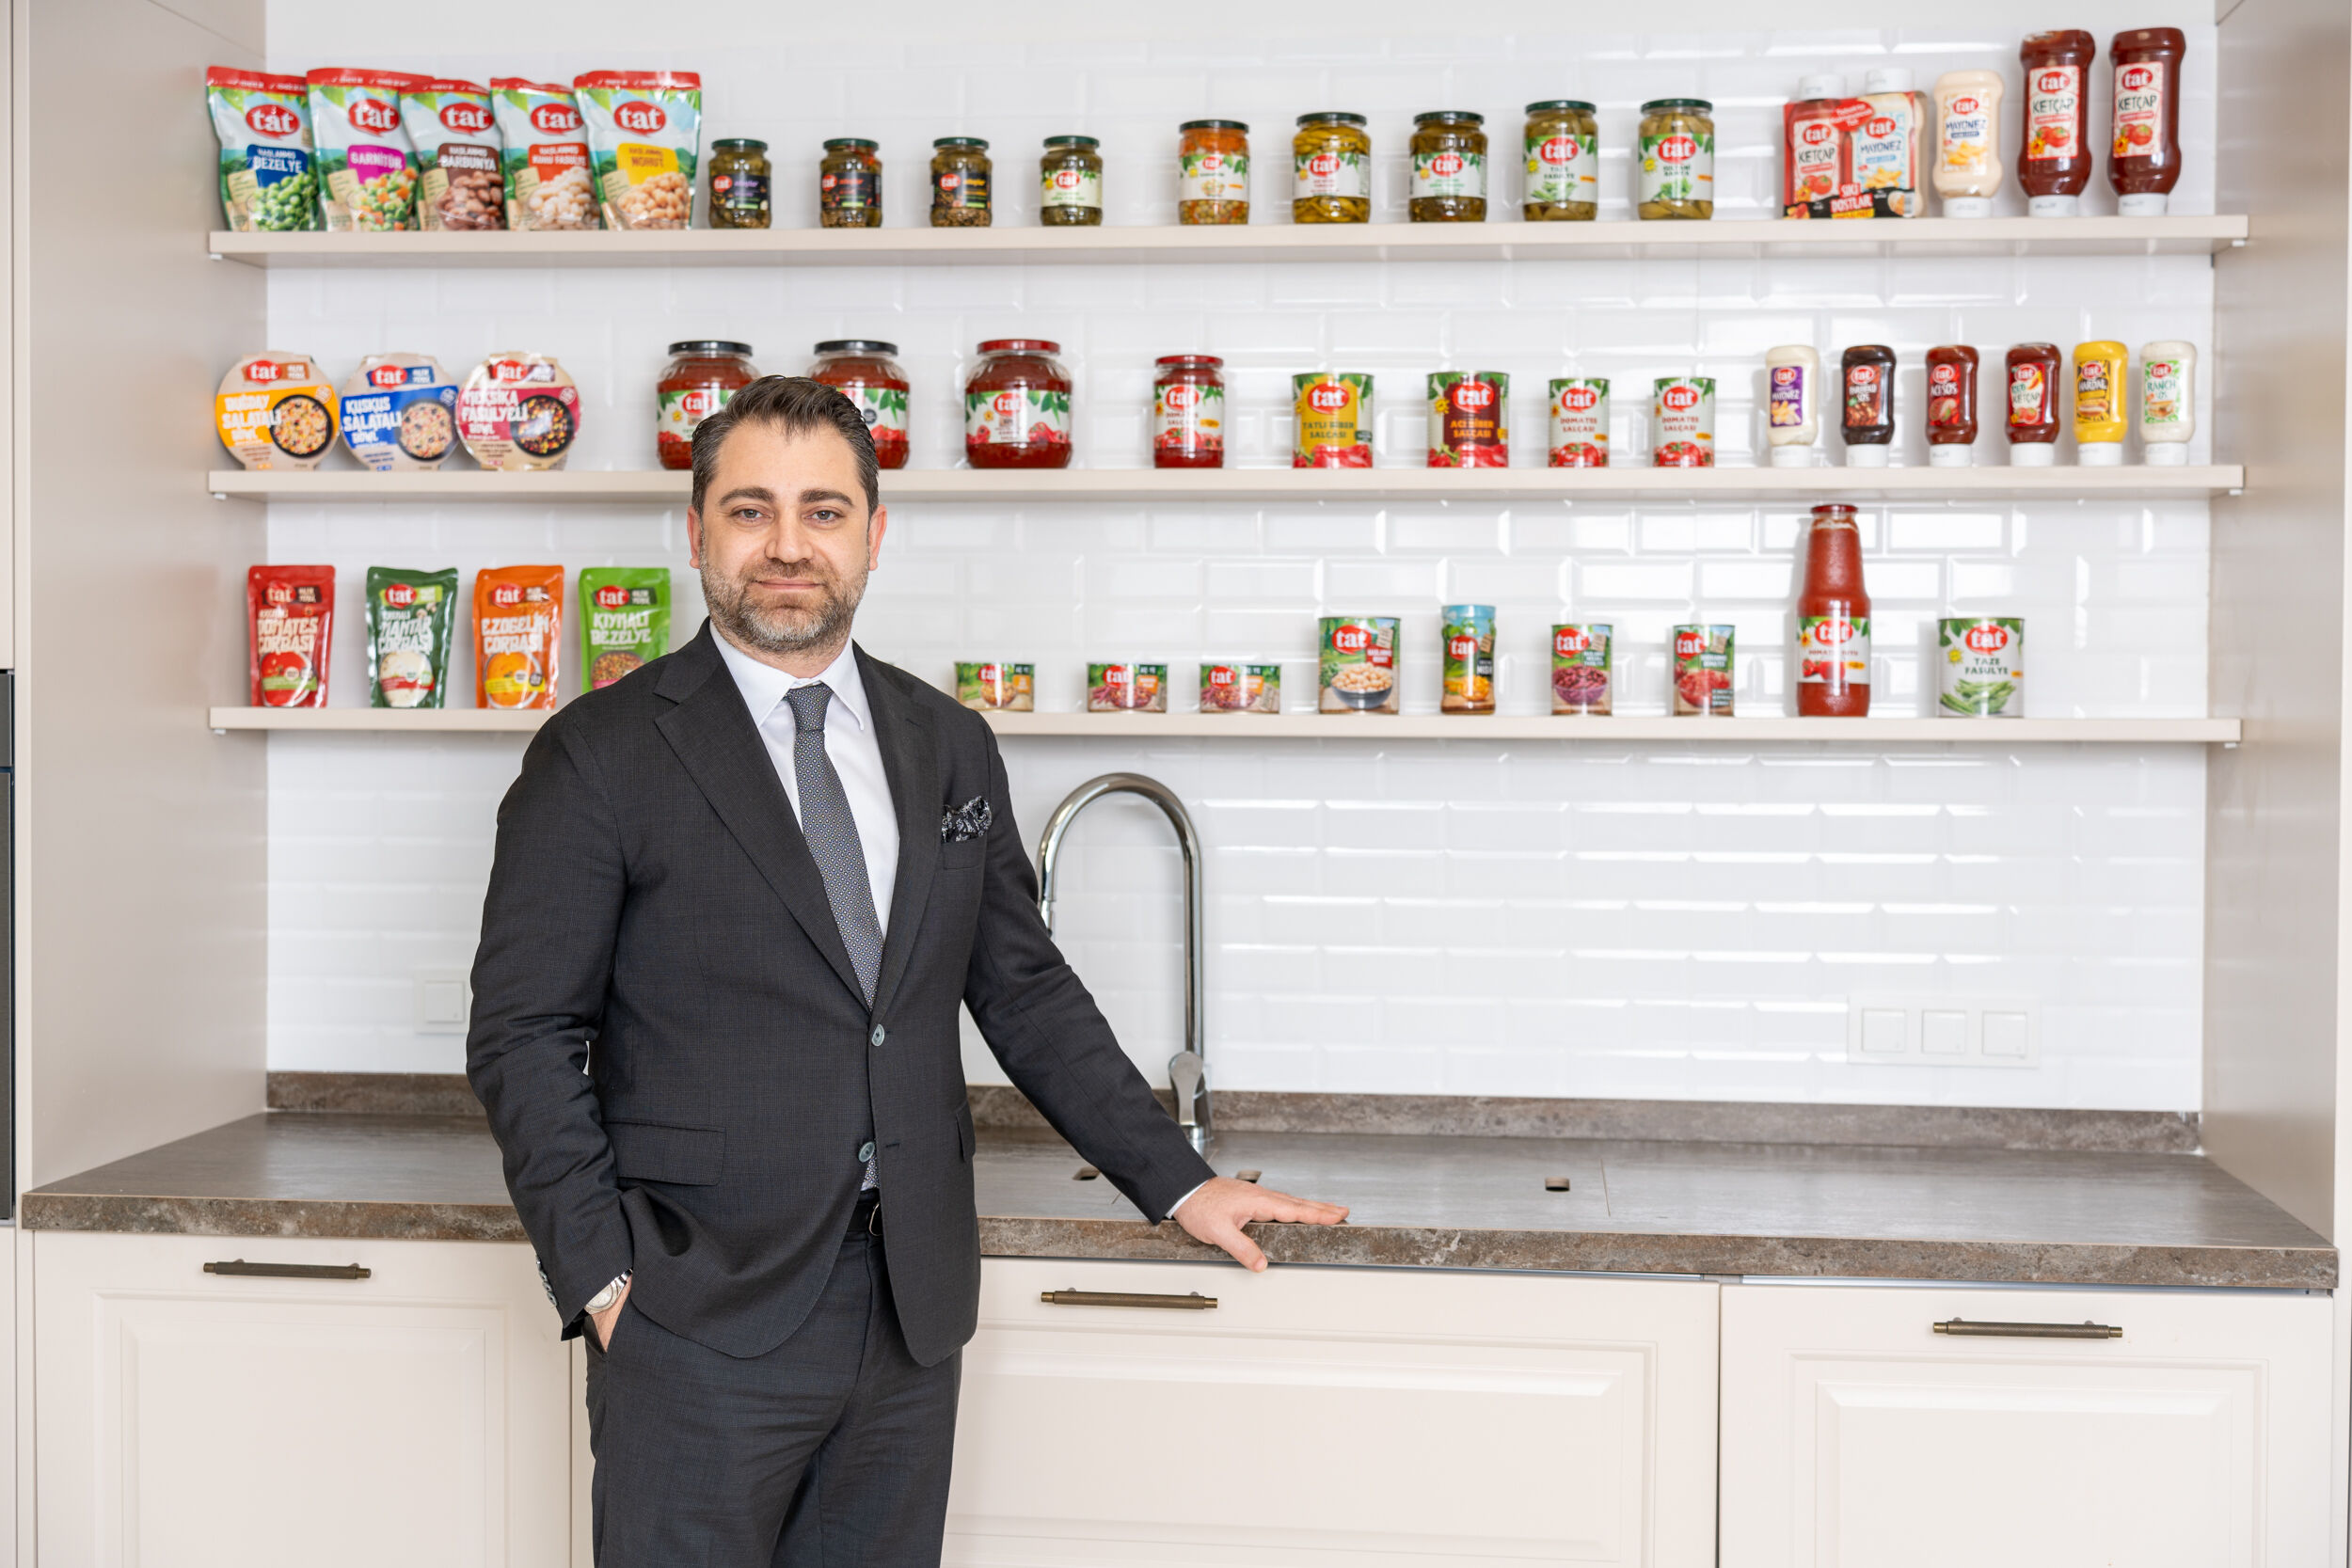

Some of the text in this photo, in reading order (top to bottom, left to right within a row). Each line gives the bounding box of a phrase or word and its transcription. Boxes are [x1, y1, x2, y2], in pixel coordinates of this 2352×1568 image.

[2040, 73, 2066, 90] tat
[2123, 71, 2148, 87] tat
[1956, 100, 1979, 114] tat
[2032, 96, 2074, 114] KETÇAP
[2118, 95, 2157, 111] KETÇAP
[251, 109, 294, 135] tat
[355, 104, 396, 129] tat
[446, 107, 490, 129] tat
[536, 108, 580, 130] tat
[619, 106, 661, 130] tat
[1868, 119, 1893, 135] tat
[1946, 119, 1987, 131] MAYONEZ
[1805, 126, 1830, 142] tat
[1545, 142, 1576, 159] tat
[1662, 141, 1692, 158] tat
[1860, 140, 1902, 154] MAYONEZ
[439, 154, 497, 171] BARBUNYA
[1798, 147, 1836, 164] KETÇAP
[253, 155, 303, 174] BEZELYE
[1435, 158, 1458, 172] tat
[1058, 175, 1078, 187] tat
[1831, 194, 1872, 213] DOSTLAR
[250, 364, 278, 380] tat
[376, 368, 404, 385] tat
[496, 364, 525, 381] tat
[1854, 369, 1873, 382] tat
[1935, 367, 1953, 382] tat
[2017, 368, 2034, 380] tat
[2083, 365, 2099, 377] tat
[2153, 365, 2169, 377] tat
[2147, 379, 2176, 392] RANCH
[224, 392, 270, 411] BUĞDAY
[685, 393, 709, 410] tat
[1311, 388, 1345, 407] tat
[1457, 387, 1490, 406] tat
[1565, 391, 1593, 407] tat
[1666, 391, 1693, 406] tat
[345, 396, 391, 414] KUSKUS
[222, 408, 282, 429] SALATALI
[342, 411, 403, 432] SALATALI
[1661, 416, 1700, 424] DOMATES
[268, 587, 294, 603] tat
[388, 588, 414, 604] tat
[495, 588, 520, 603] tat
[598, 589, 626, 605] tat
[257, 616, 319, 636] DOMATES
[380, 616, 433, 638] MANTAR
[481, 613, 549, 636] EZOGELİN
[593, 610, 650, 628] KIYMALI
[590, 628, 652, 645] BEZELYE
[1336, 629, 1368, 649] tat
[1556, 634, 1584, 651] tat
[1971, 629, 2004, 649] tat
[1451, 640, 1474, 656] tat
[1677, 638, 1701, 654] tat
[1975, 657, 2001, 666] TAZE
[980, 667, 1001, 680] ta
[1106, 669, 1131, 683] tat
[1211, 671, 1232, 684] tat
[1964, 666, 2009, 675] FASULYE
